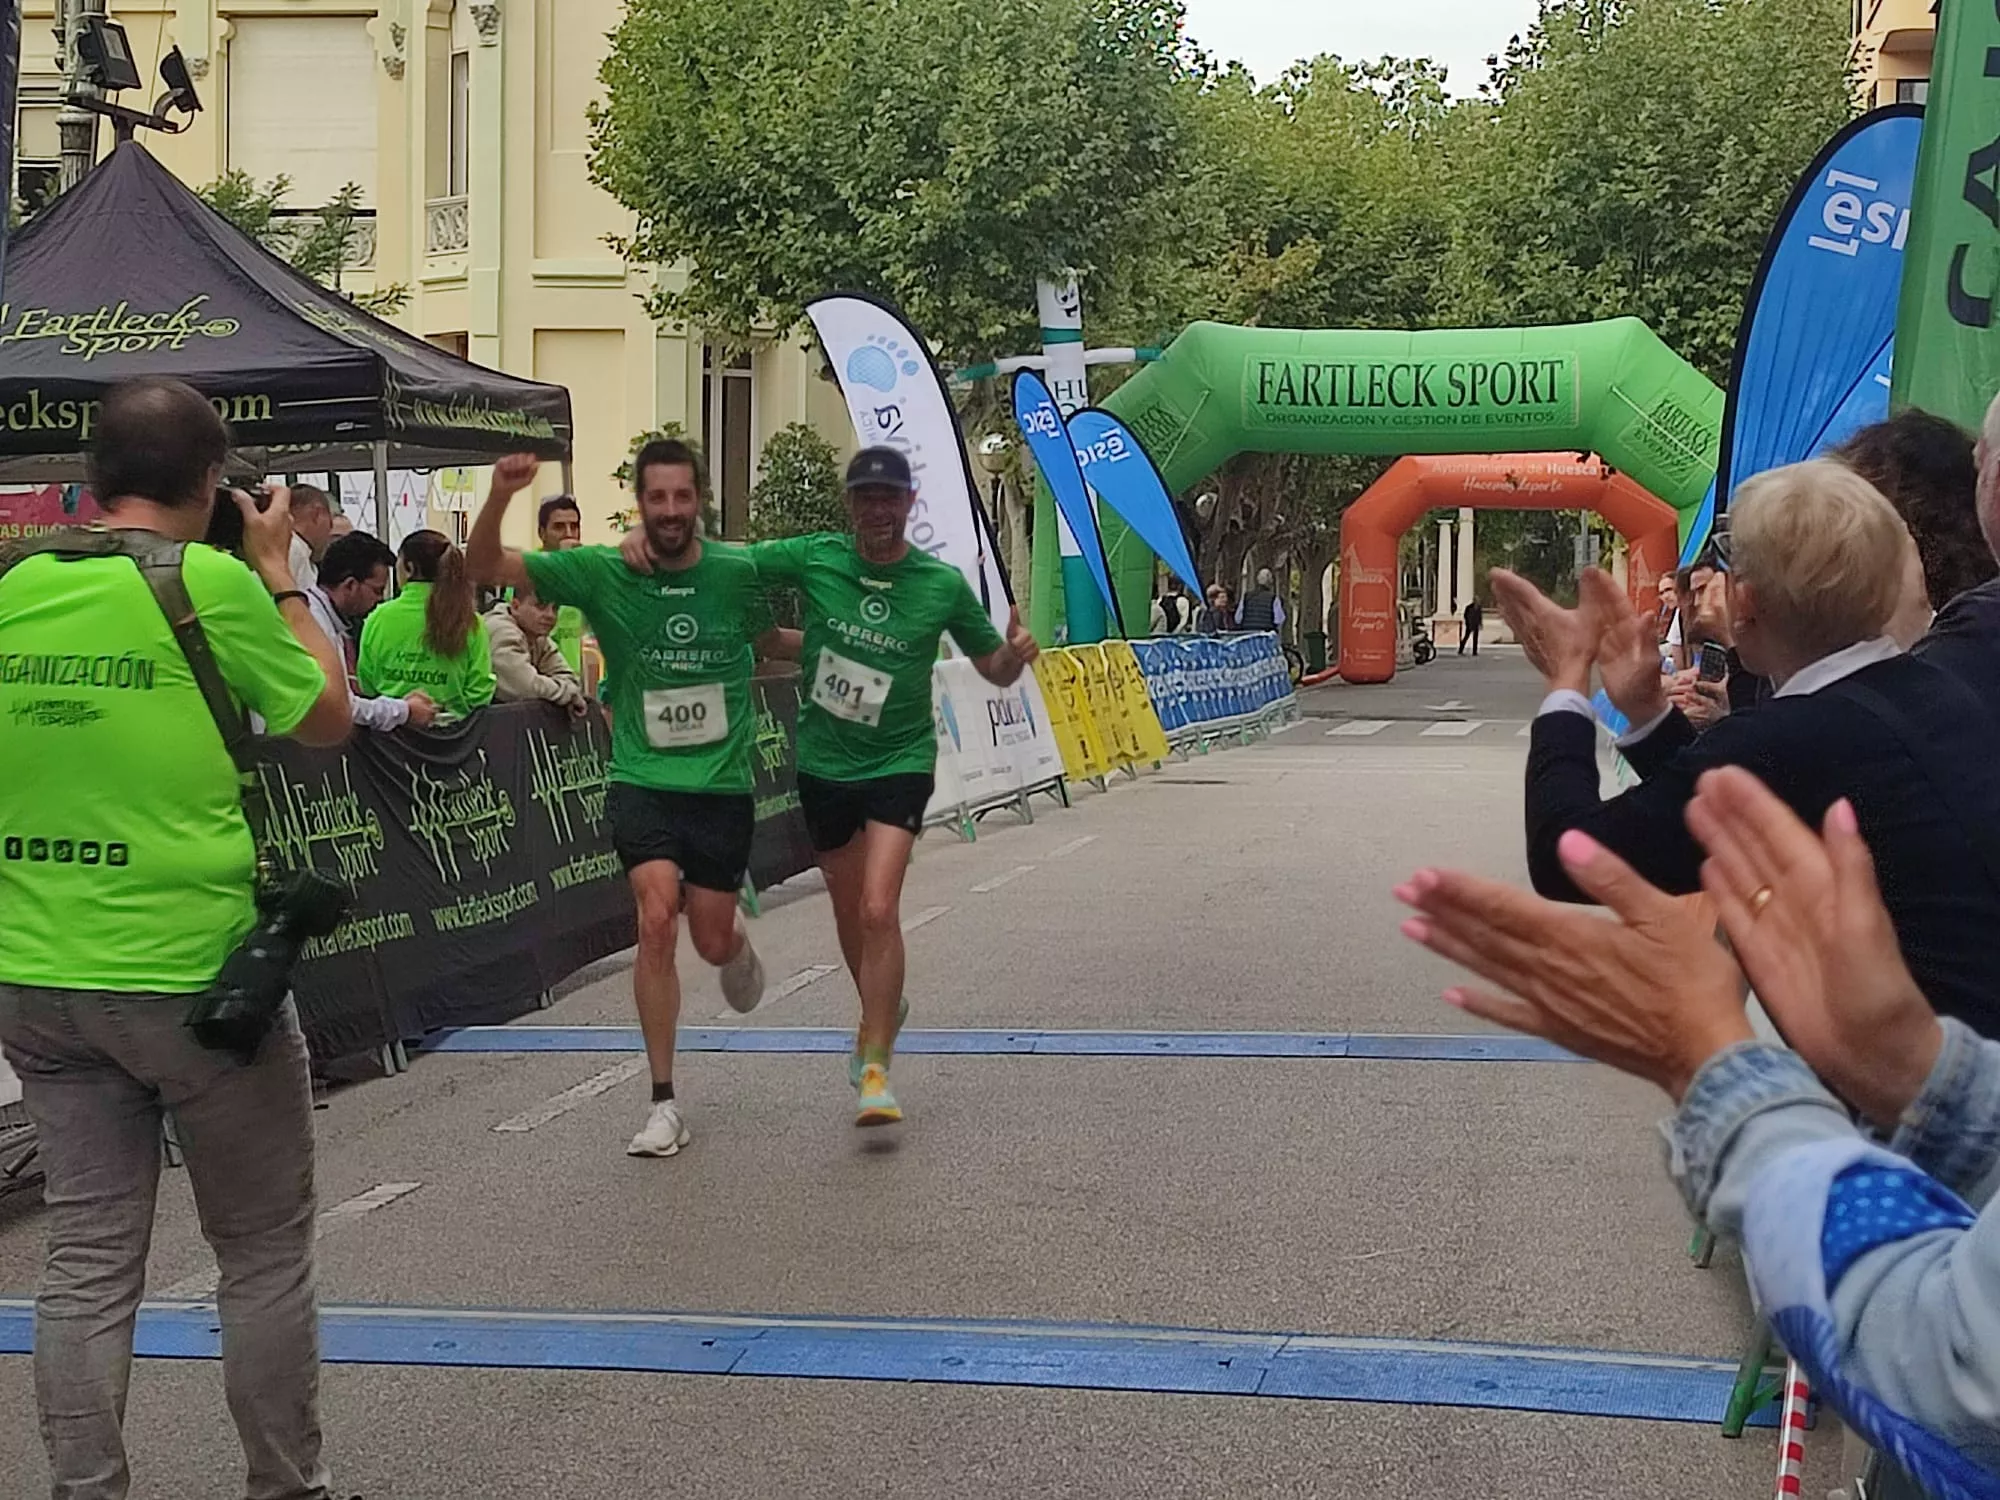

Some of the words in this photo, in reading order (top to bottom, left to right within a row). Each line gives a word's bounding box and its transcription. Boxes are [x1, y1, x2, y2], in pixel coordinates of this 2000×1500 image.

[60, 328, 192, 361] Sport
[1257, 361, 1438, 408] FARTLECK
[1447, 360, 1564, 407] SPORT
[1461, 412, 1481, 425] DE
[1485, 410, 1555, 424] EVENTOS
[1547, 462, 1597, 476] Huesca
[826, 617, 909, 652] CABRERO
[0, 651, 156, 690] GANIZACIÓN
[824, 674, 865, 706] 401
[658, 702, 706, 725] 400
